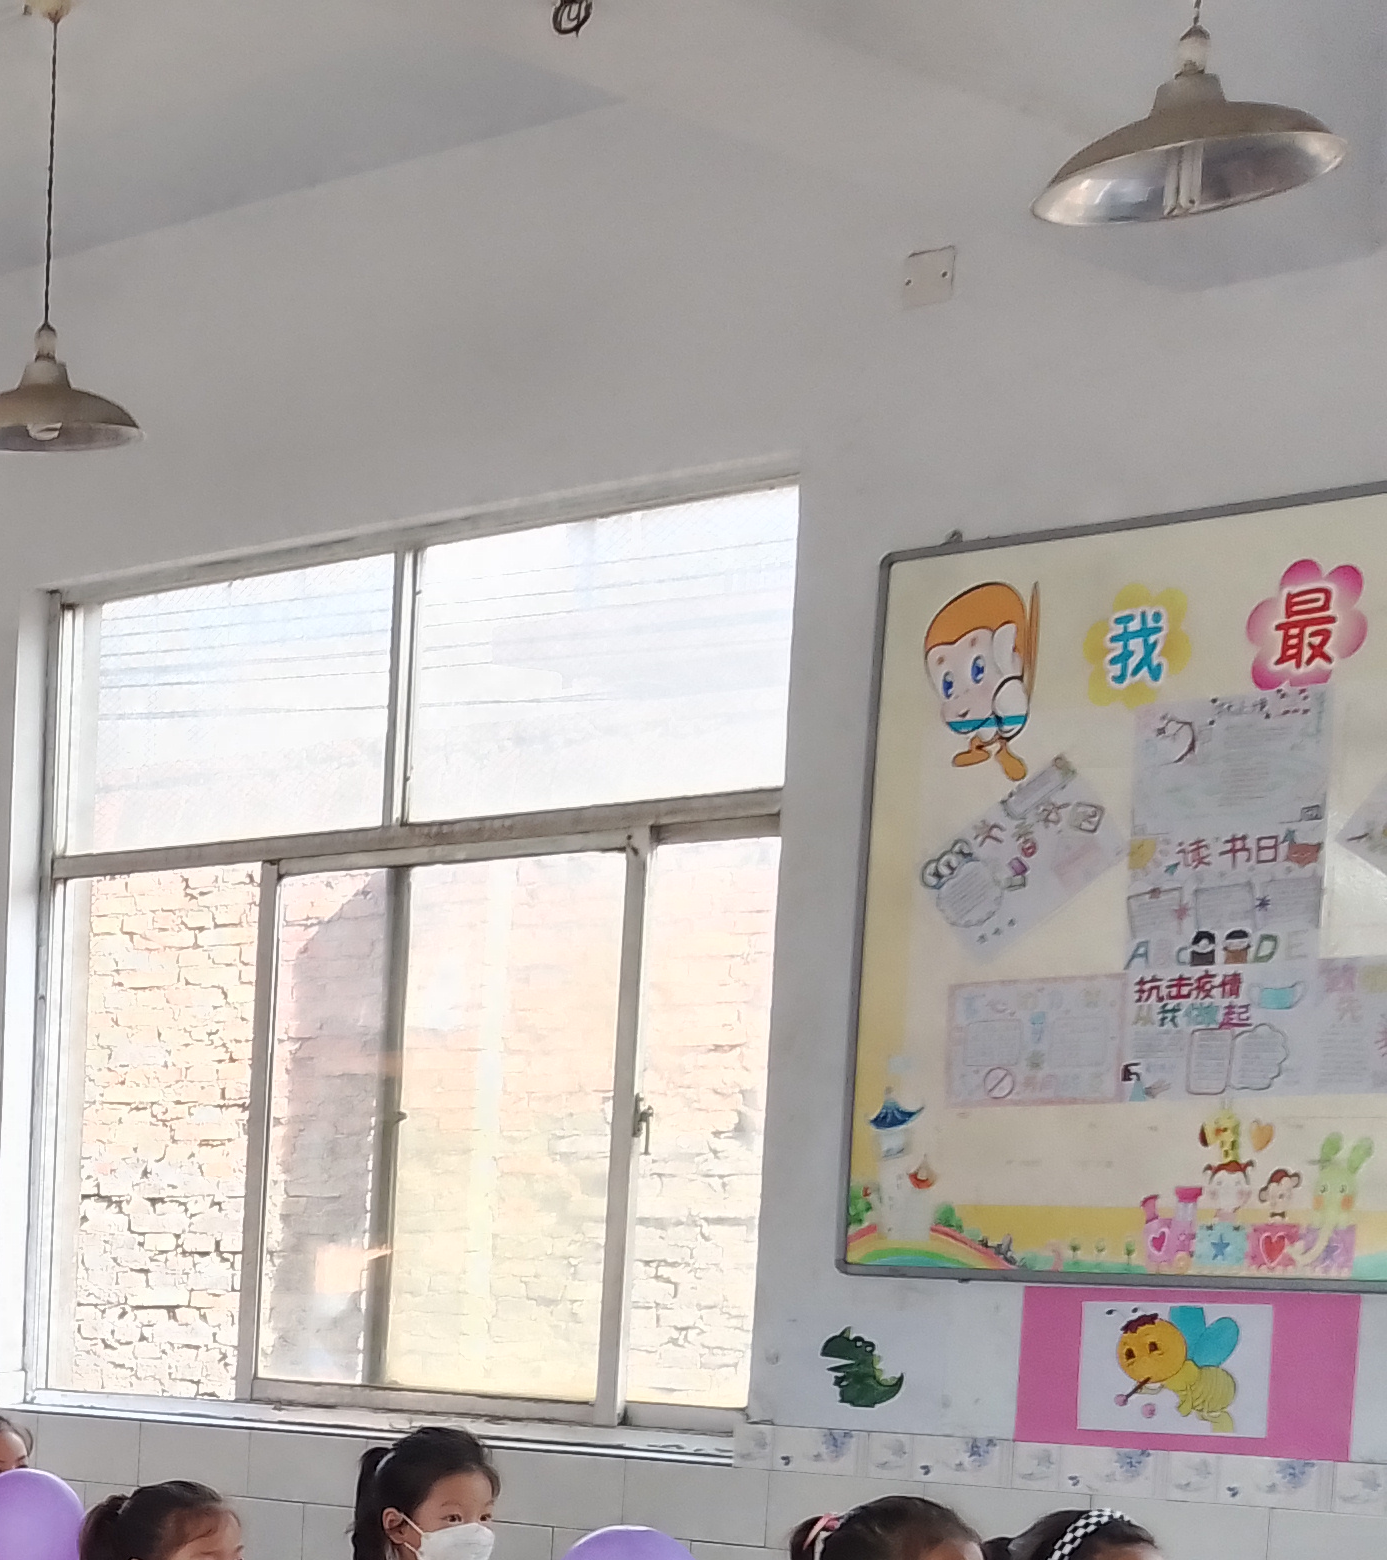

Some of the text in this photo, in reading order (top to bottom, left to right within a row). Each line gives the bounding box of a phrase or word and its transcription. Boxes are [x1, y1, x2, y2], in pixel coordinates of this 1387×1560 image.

[1133, 969, 1243, 1003] 抗击疫情
[1131, 1003, 1254, 1030] 从我做起
